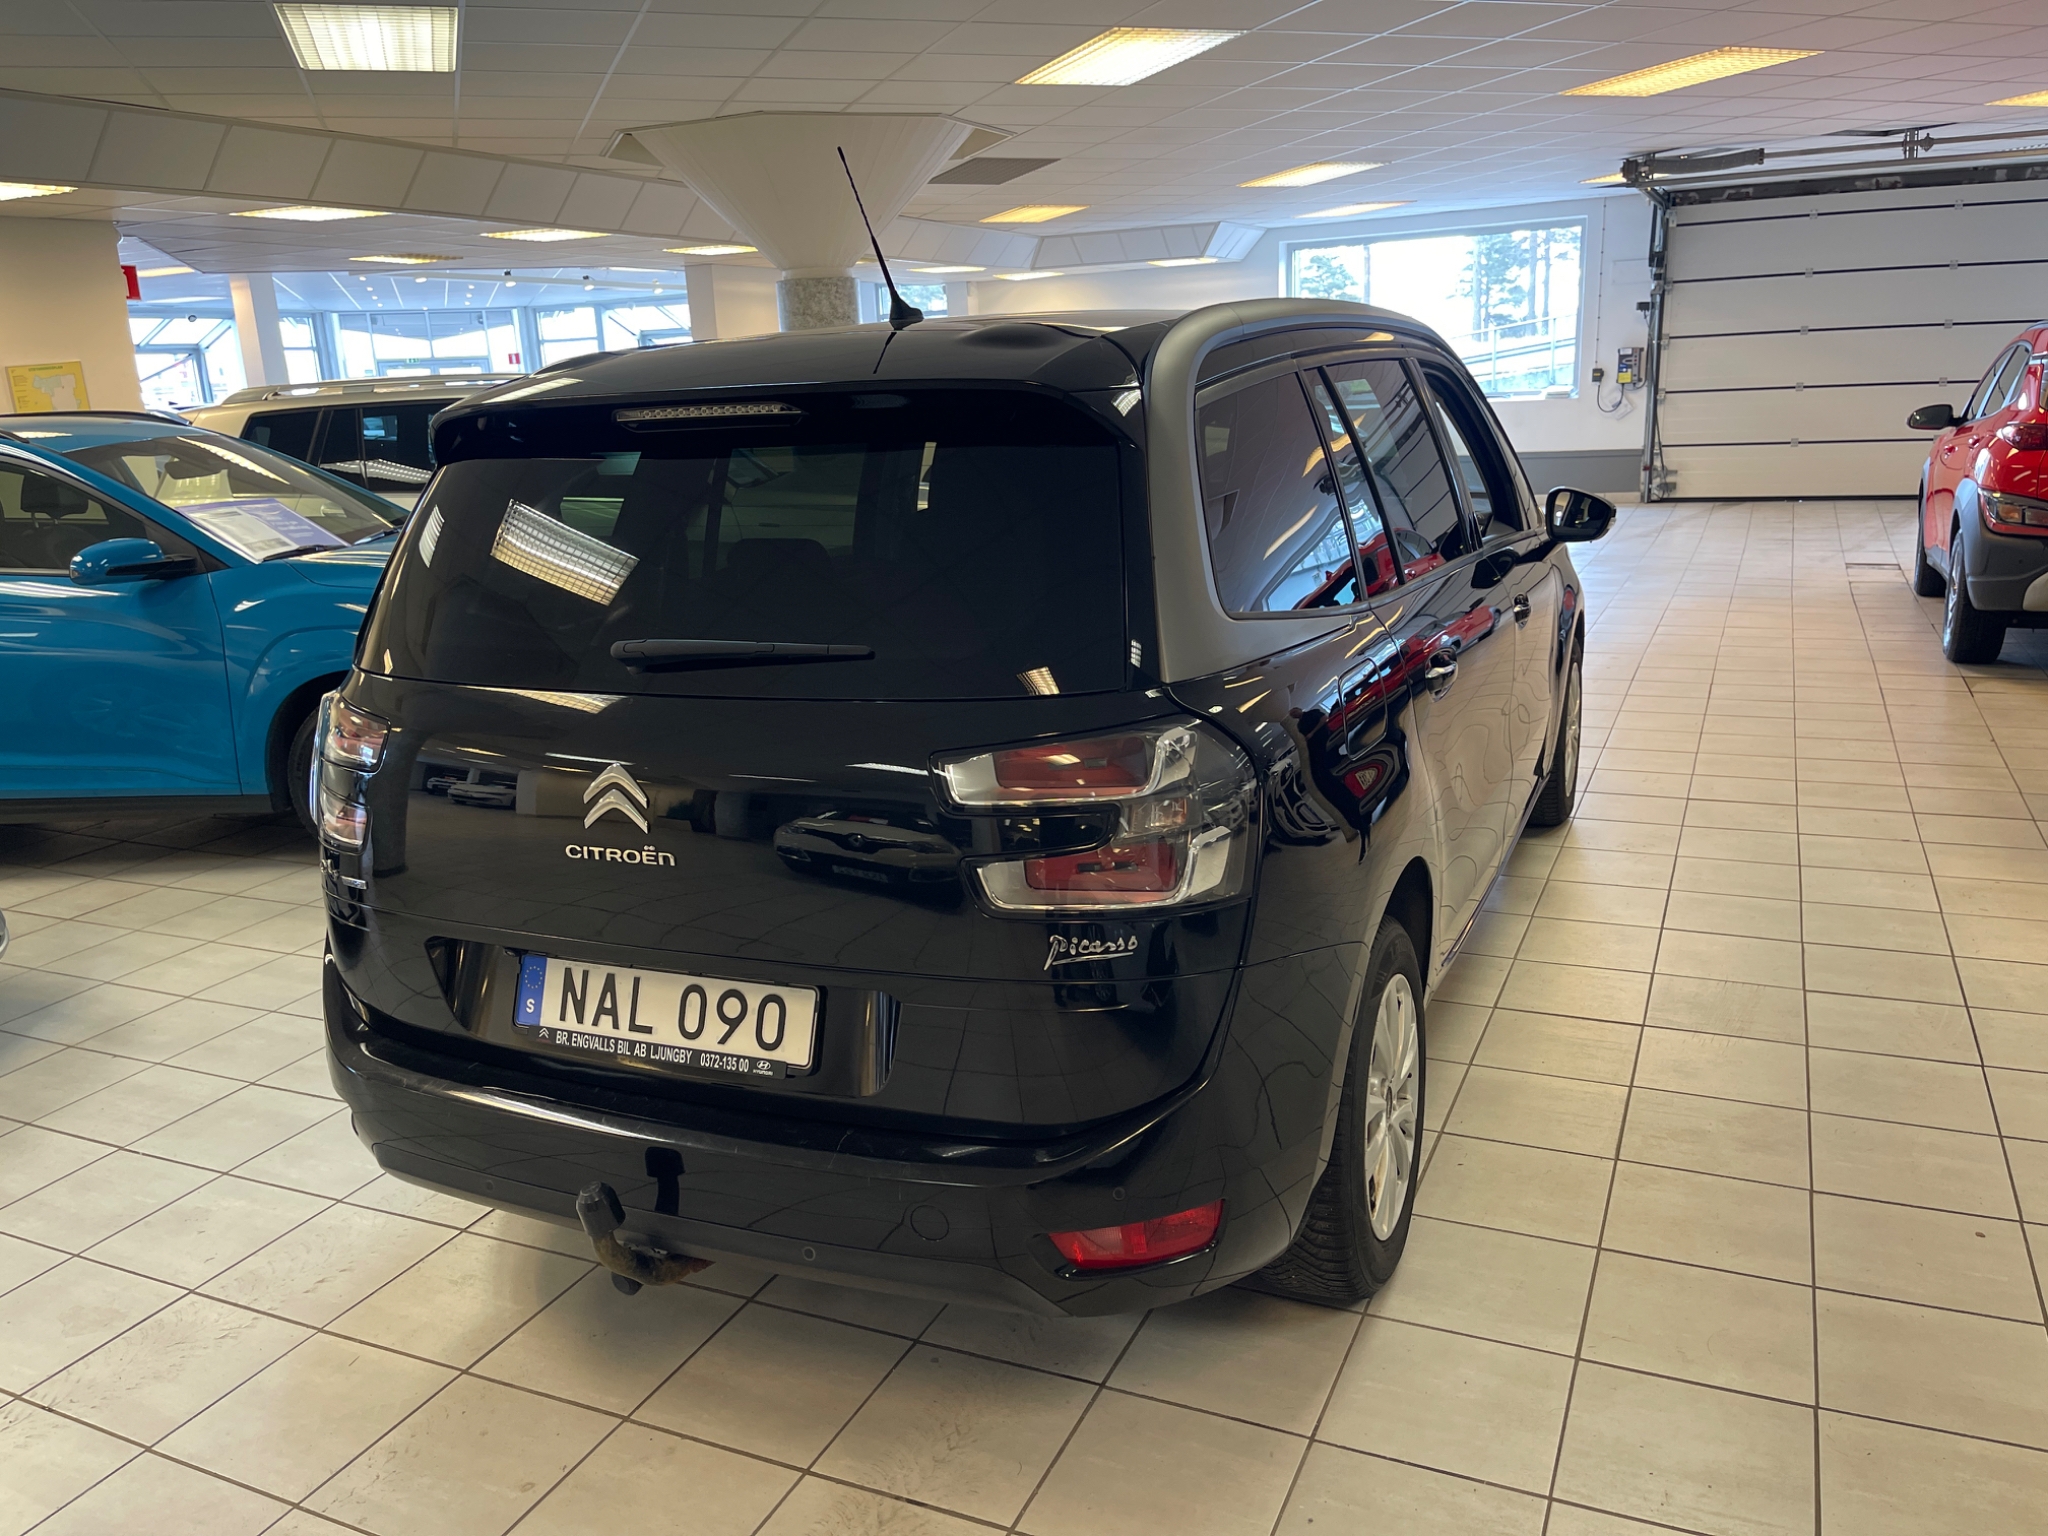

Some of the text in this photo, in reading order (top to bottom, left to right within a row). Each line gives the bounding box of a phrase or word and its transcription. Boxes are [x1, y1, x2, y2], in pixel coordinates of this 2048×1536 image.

[565, 844, 676, 867] CITROËN
[1043, 934, 1138, 971] Picasso
[525, 998, 535, 1014] S
[559, 967, 787, 1052] NAL 090
[555, 1030, 750, 1073] BR. ENGVALLS BIL AB LJUNGBY 0372-135 00
